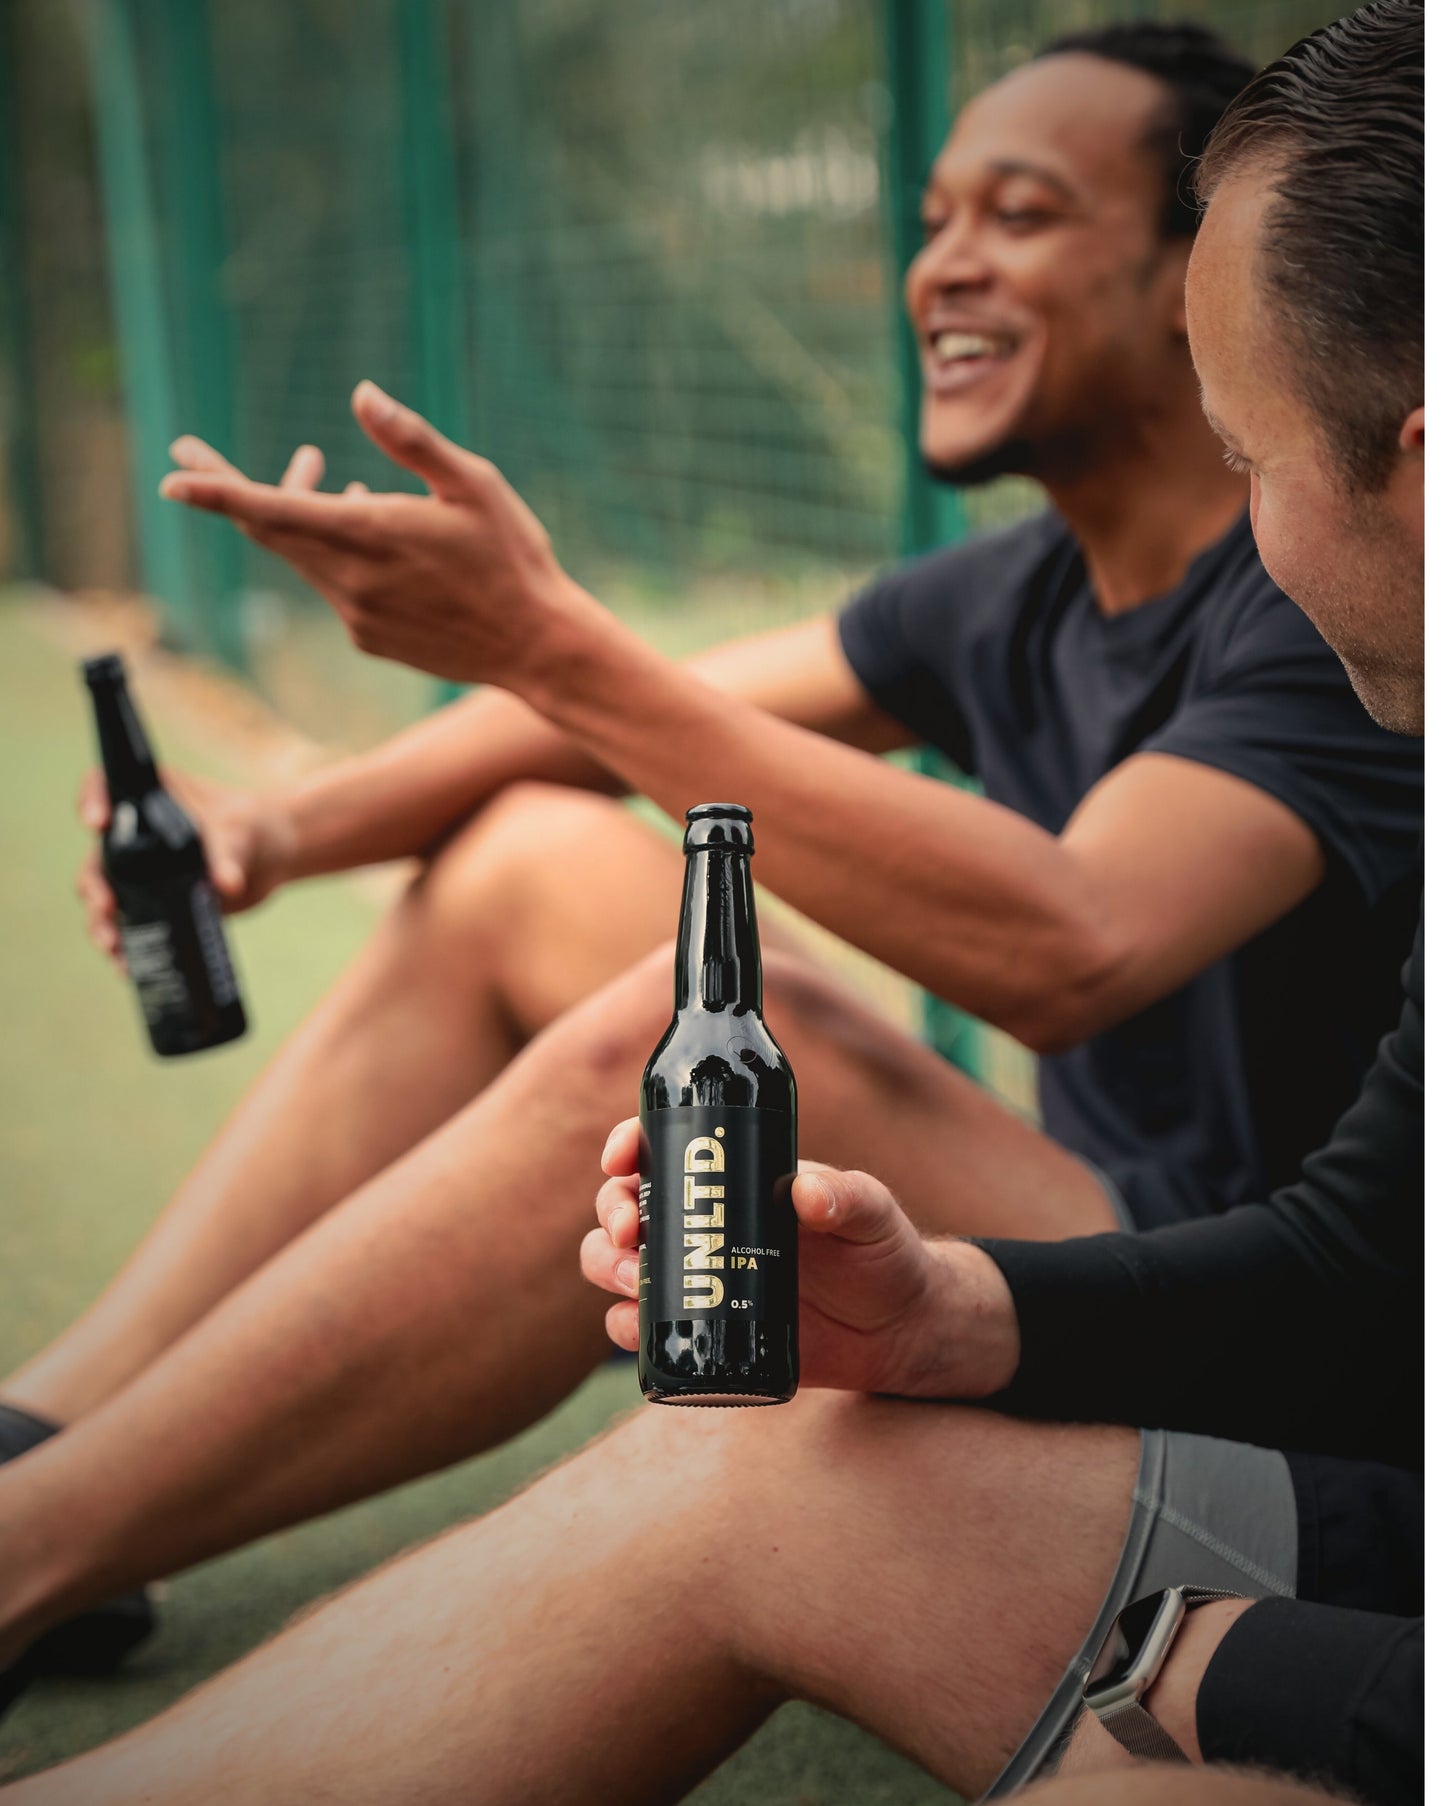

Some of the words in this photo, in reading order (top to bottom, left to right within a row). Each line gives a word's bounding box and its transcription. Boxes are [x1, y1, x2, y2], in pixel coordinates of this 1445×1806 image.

[683, 1126, 725, 1309] UNLTD.
[731, 1246, 765, 1256] ALCOHOL
[766, 1248, 780, 1257] FREE
[731, 1256, 758, 1270] IPA
